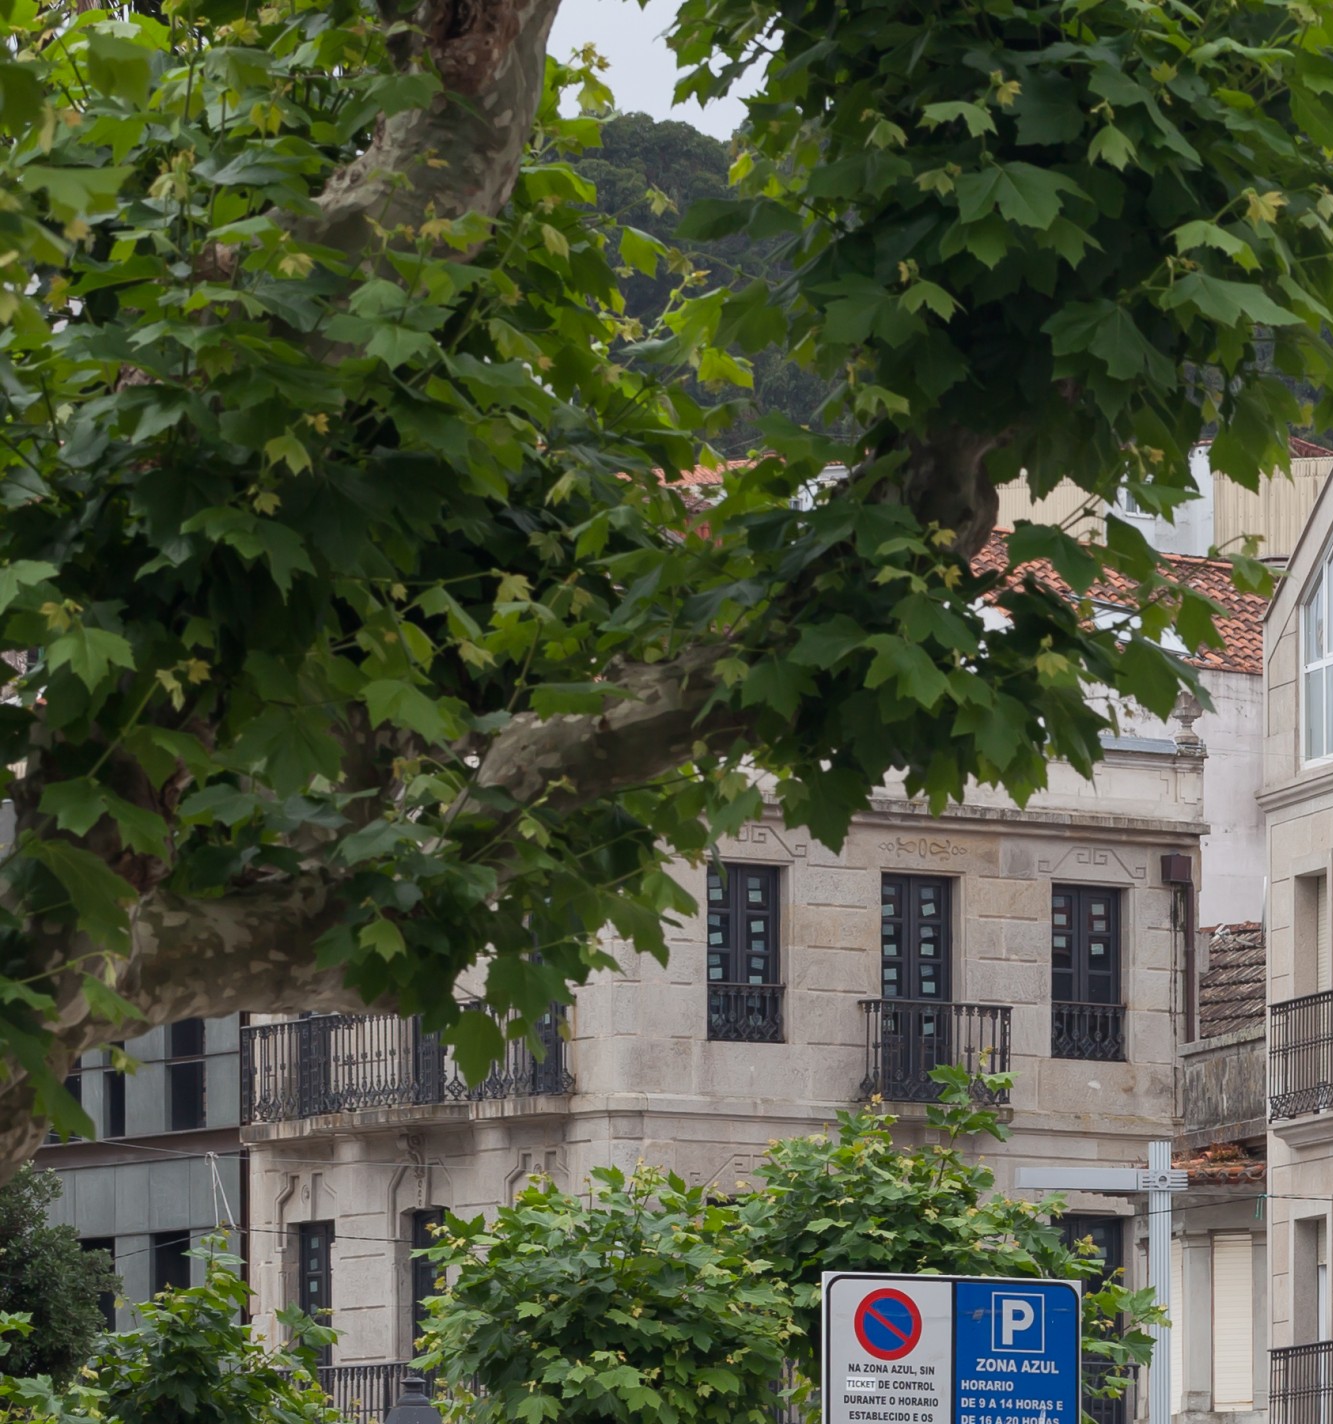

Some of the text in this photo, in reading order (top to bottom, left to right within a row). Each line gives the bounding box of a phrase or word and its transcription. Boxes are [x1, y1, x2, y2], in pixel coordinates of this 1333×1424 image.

[1002, 1299, 1034, 1345] P
[848, 1364, 935, 1376] NA ZONA AZUL, SIN
[976, 1359, 1059, 1374] ZONA AZUL
[847, 1380, 935, 1391] TICKET DE CONTROL
[961, 1380, 1013, 1391] HORARIO
[844, 1395, 938, 1407] DURANTE O HORARIO
[961, 1398, 1063, 1410] DE 9 A 14 HORAS E
[849, 1412, 933, 1423] ESTABLECIDO E OS
[961, 1415, 976, 1424] DE
